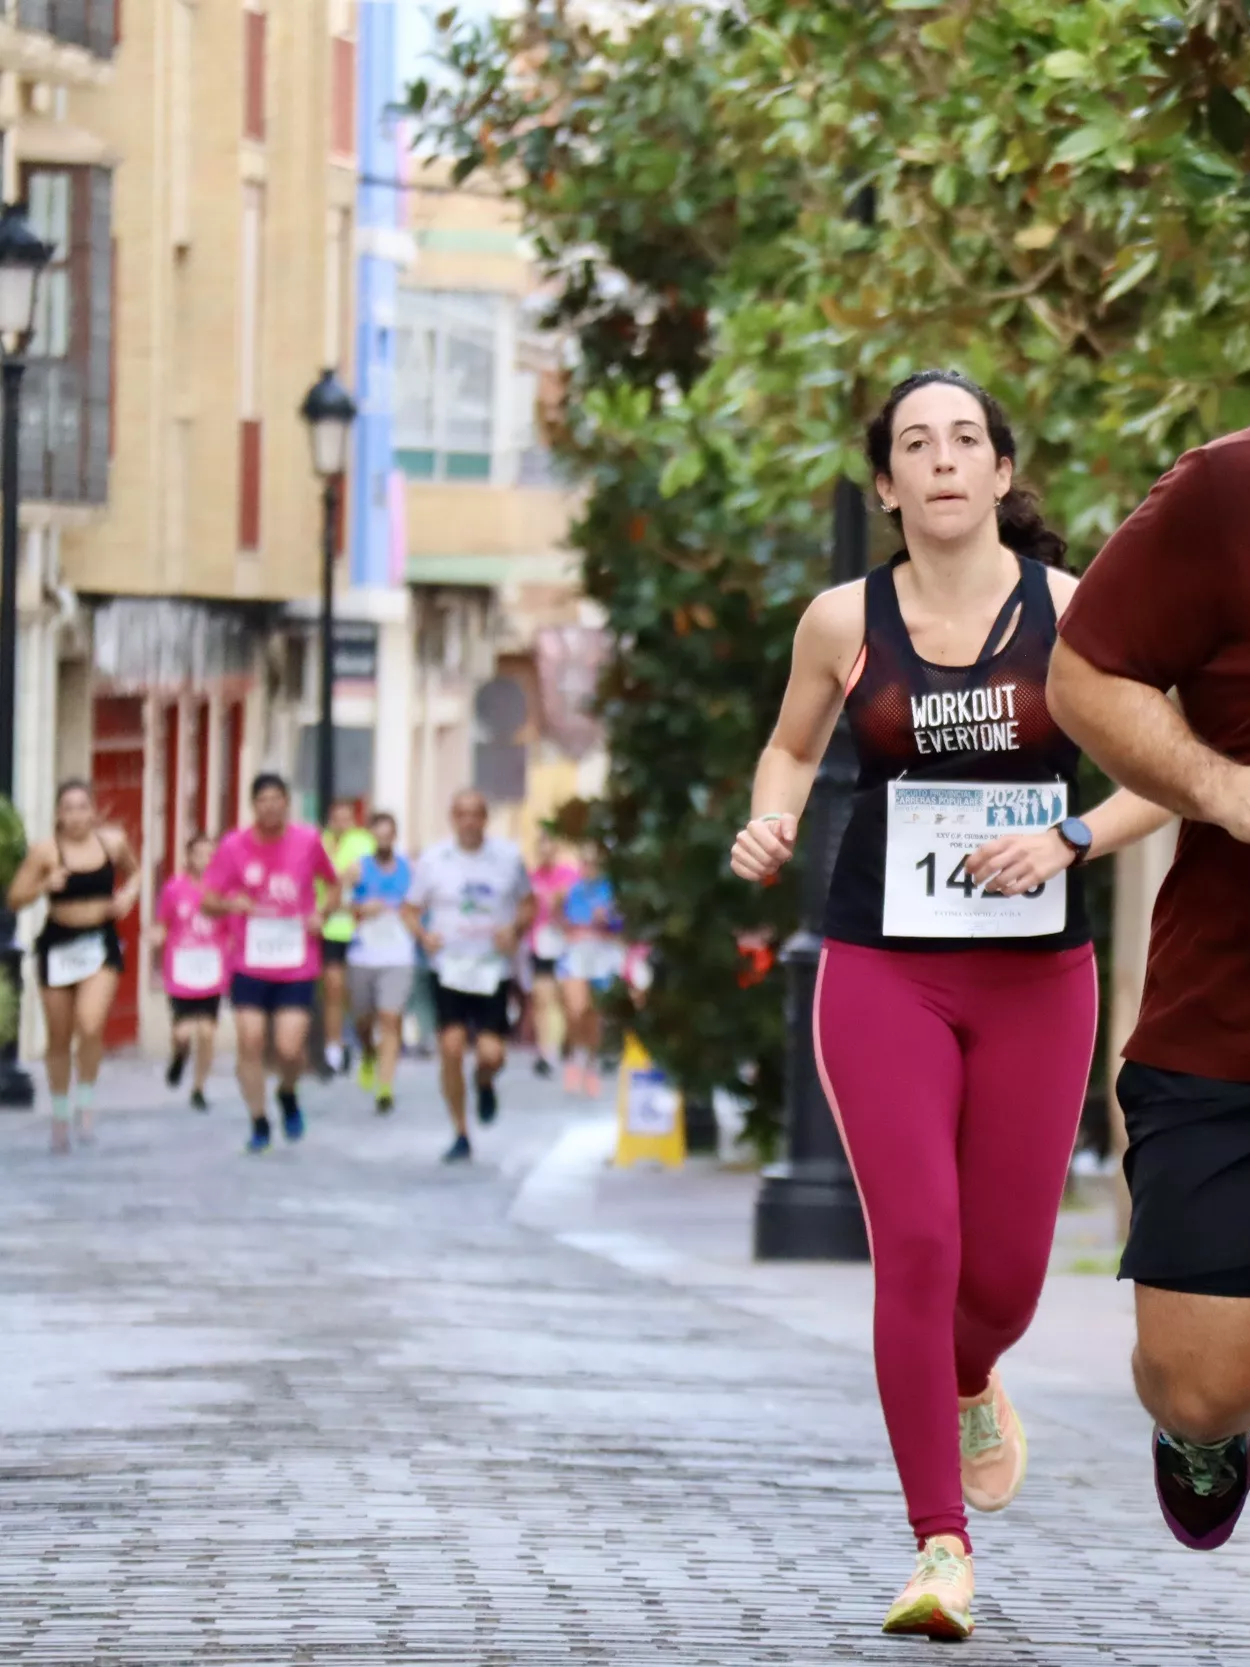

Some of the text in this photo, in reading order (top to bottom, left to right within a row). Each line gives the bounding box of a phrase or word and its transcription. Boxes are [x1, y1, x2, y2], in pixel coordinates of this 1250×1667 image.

[911, 684, 1016, 729] WORKOUT
[914, 721, 1020, 754] EVERYONE
[895, 796, 984, 806] CARRERAS POPULARES
[985, 788, 1029, 807] 2024
